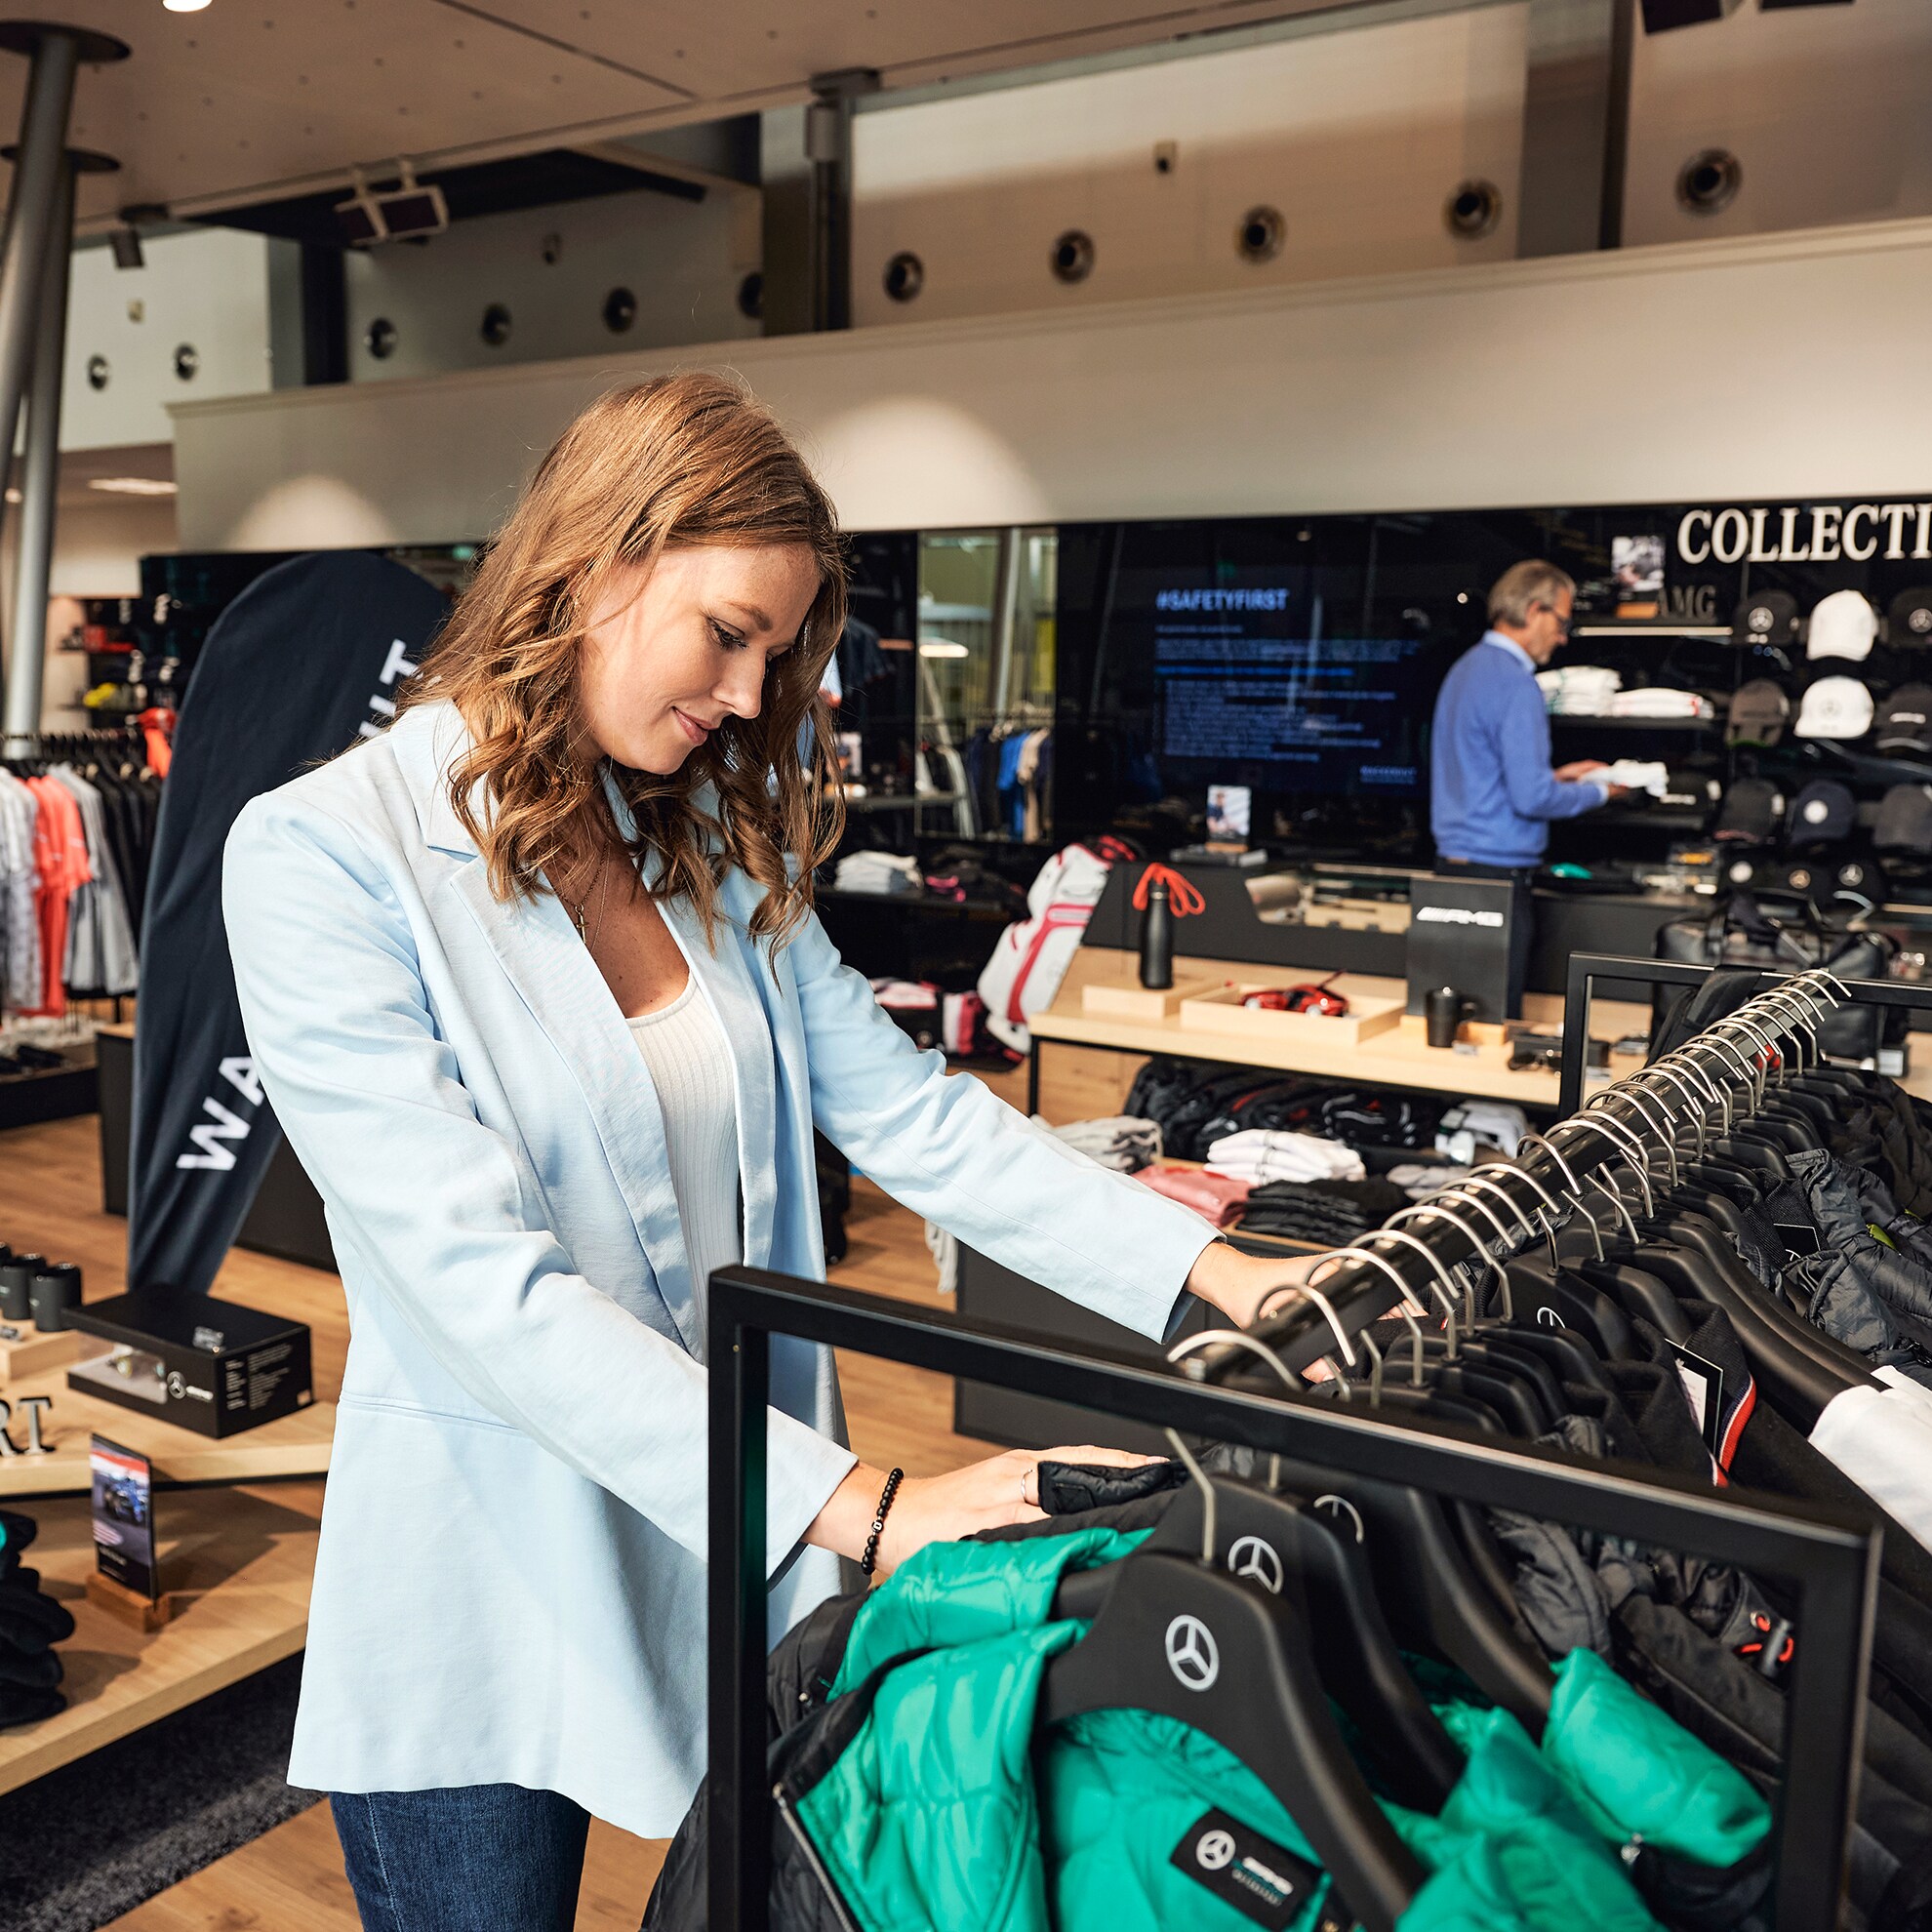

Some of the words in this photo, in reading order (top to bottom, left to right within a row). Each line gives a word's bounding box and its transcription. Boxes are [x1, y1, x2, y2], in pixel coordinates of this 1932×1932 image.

[1677, 503, 1932, 565] COLLECTI
[1155, 587, 1290, 612] #SAFETYFIRST
[176, 1056, 265, 1171] WA
